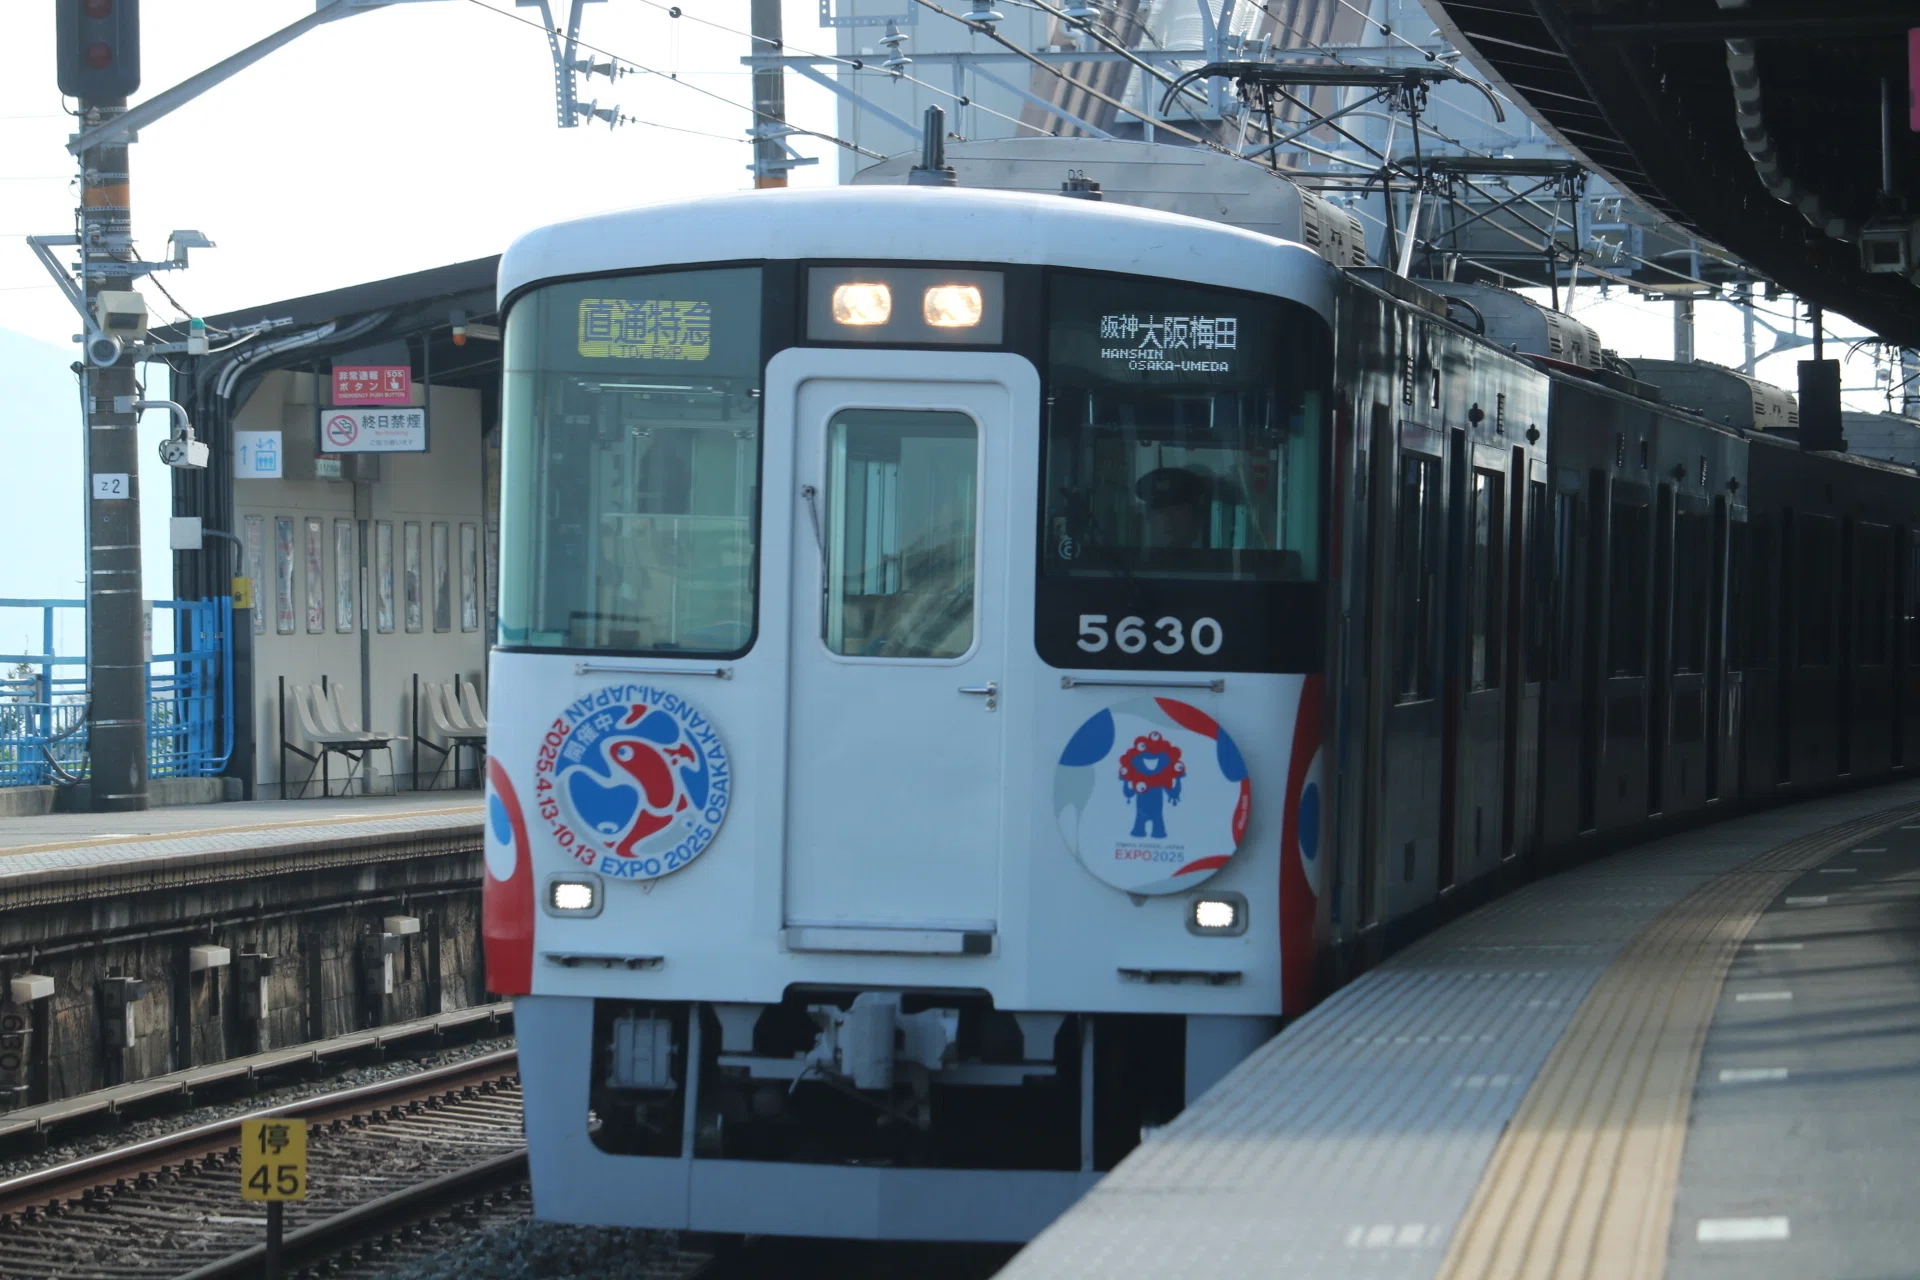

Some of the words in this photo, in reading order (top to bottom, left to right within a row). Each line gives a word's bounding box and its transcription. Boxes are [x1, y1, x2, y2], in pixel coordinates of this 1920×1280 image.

[584, 301, 711, 345] 直通特急
[1100, 314, 1237, 350] 阪神大阪梅田
[1101, 348, 1164, 360] HANSHIN
[1128, 360, 1229, 372] OSAKA-UMEDA
[338, 370, 379, 381] 非常通報
[339, 382, 379, 391] ボタン
[362, 413, 421, 429] 終日禁煙
[1076, 614, 1223, 656] 5630
[563, 713, 614, 764] 開催中
[600, 856, 661, 878] EXPO
[663, 824, 713, 870] 2025
[258, 1123, 291, 1155] 停
[248, 1164, 299, 1196] 45
